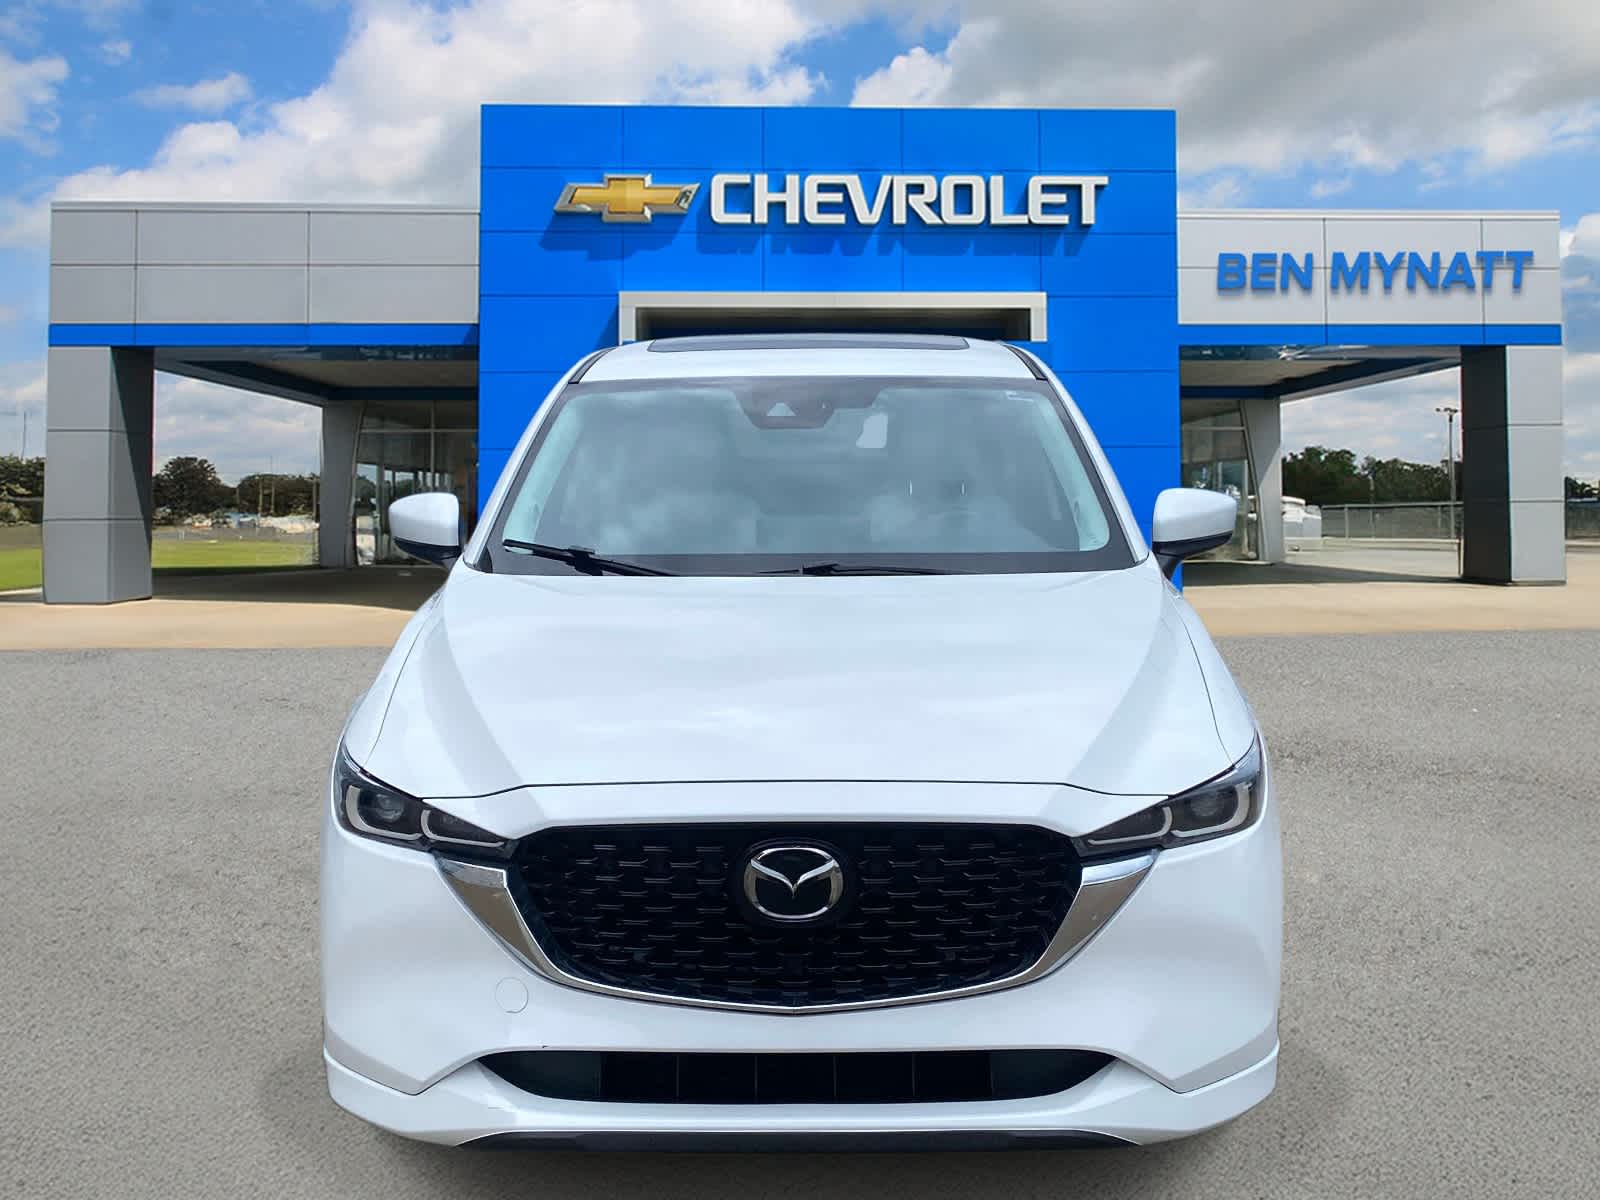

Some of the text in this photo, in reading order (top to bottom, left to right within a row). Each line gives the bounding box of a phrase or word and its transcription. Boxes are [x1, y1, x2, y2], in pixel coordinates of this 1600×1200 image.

[710, 174, 1109, 226] CHEVROLET
[1217, 251, 1534, 291] BEN MYNATT
